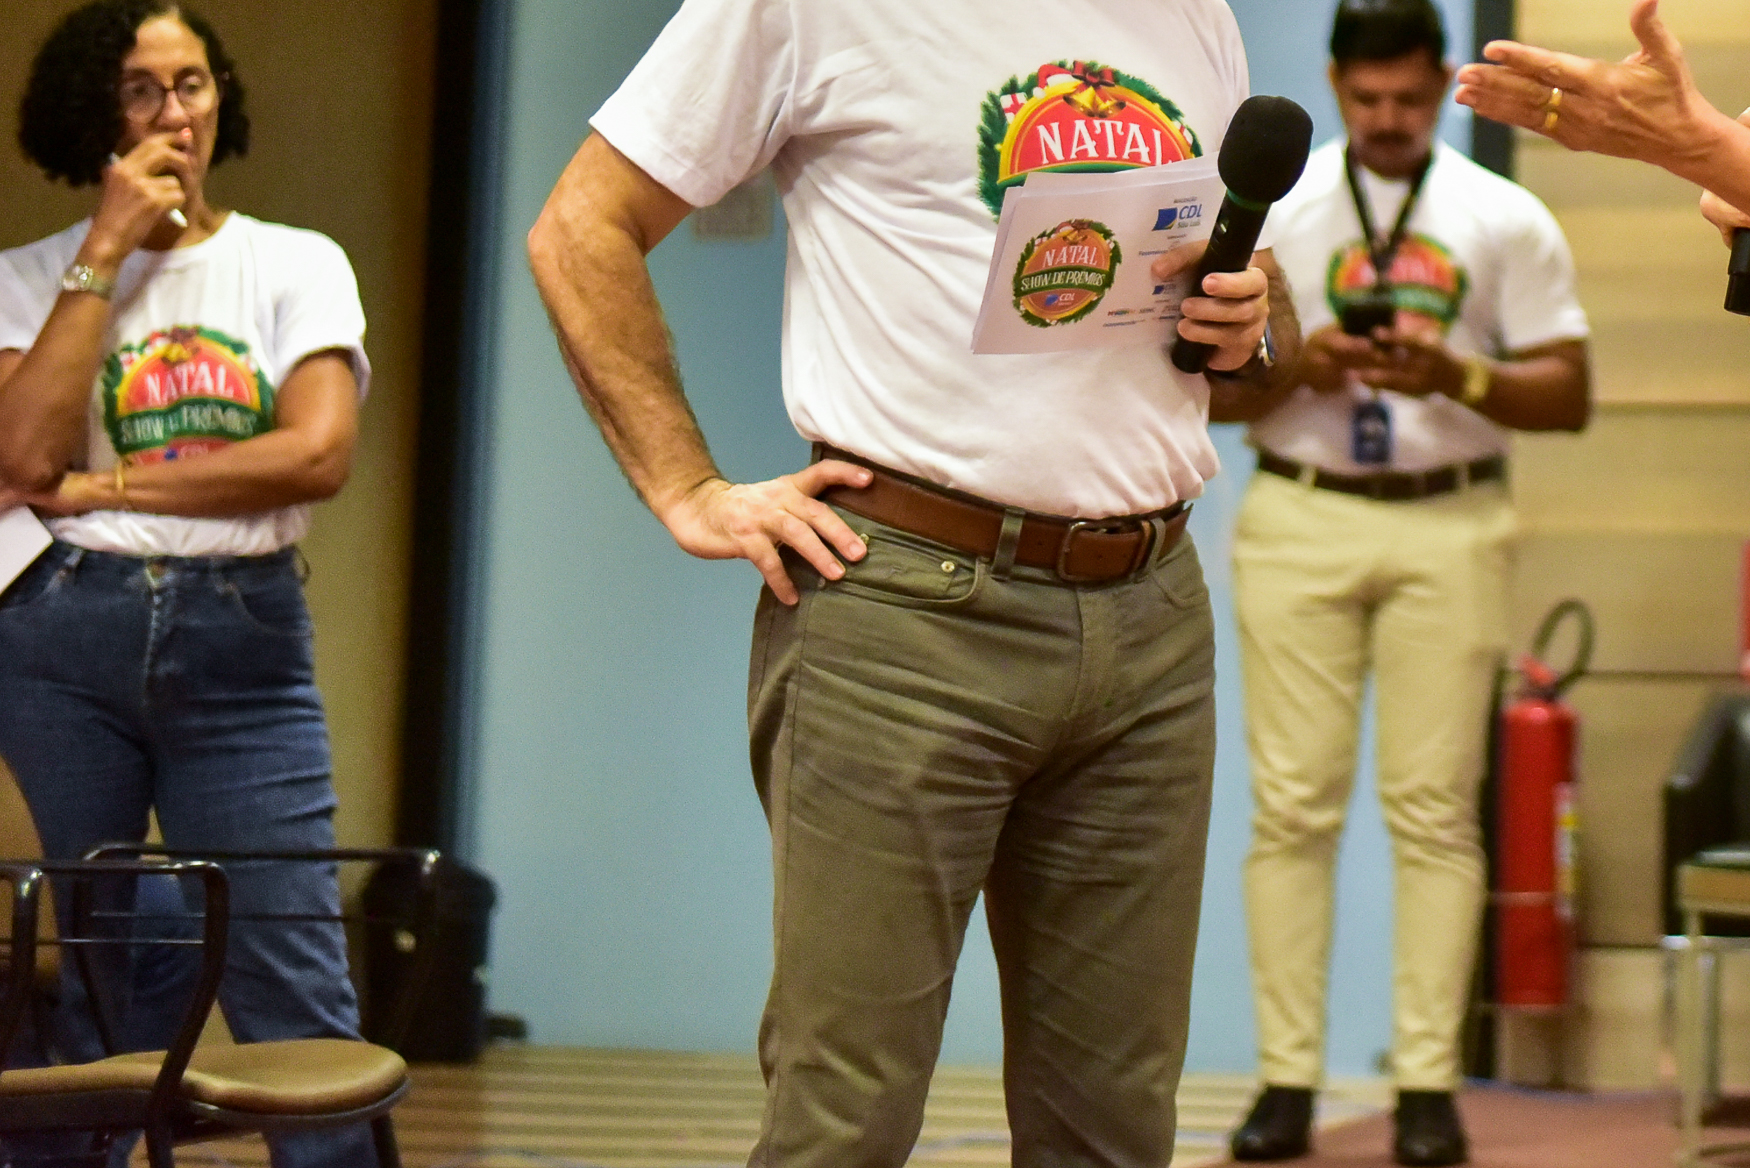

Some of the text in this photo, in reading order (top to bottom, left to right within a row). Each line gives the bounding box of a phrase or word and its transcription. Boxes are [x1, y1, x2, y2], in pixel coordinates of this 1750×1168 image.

[1036, 119, 1173, 166] NATAL
[1178, 203, 1203, 220] CDL
[1042, 245, 1098, 268] NATAL
[1021, 273, 1052, 291] SHOW
[1052, 272, 1066, 285] DE
[145, 361, 235, 407] NATAL
